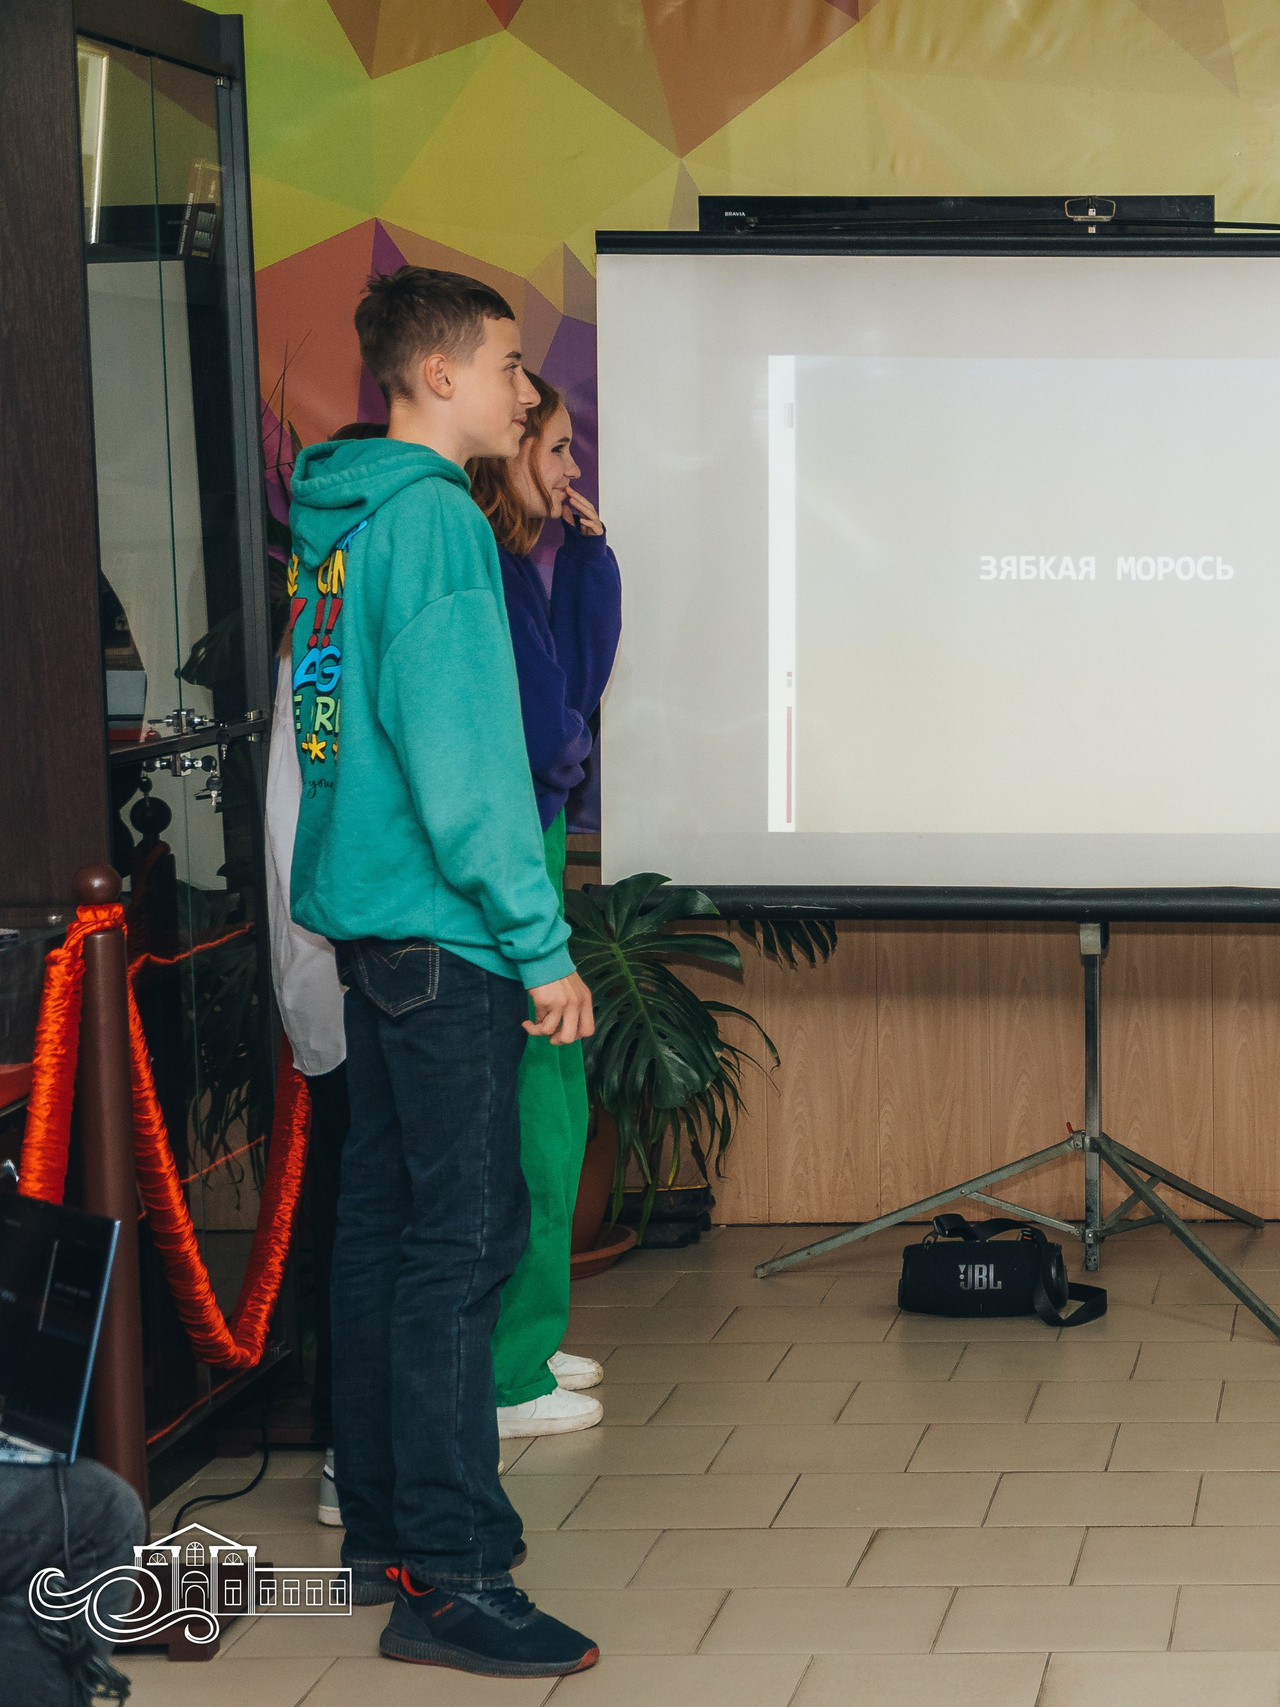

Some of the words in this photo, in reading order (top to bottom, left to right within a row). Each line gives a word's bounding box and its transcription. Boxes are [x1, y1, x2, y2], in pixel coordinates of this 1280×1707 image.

[979, 555, 1097, 581] ЗЯБКАЯ
[1115, 555, 1235, 581] МОРОСЬ
[959, 1263, 1002, 1291] JBL
